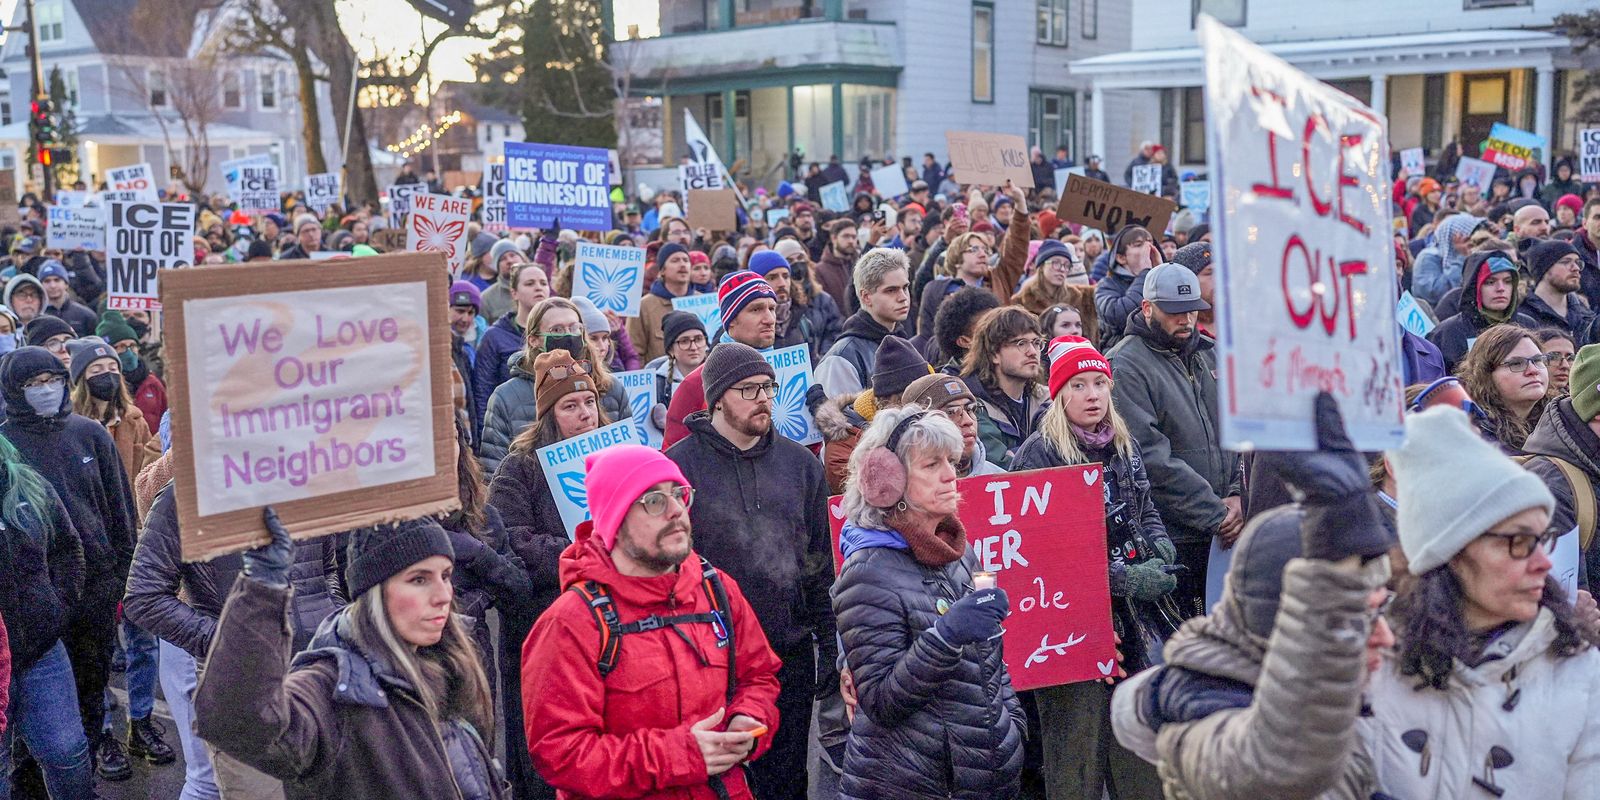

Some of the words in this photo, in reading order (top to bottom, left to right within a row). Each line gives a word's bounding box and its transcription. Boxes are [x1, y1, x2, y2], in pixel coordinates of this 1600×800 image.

[1584, 132, 1600, 143] IC
[1586, 144, 1600, 155] OU
[506, 147, 529, 156] Leave
[545, 151, 585, 160] neighbors
[1000, 147, 1025, 167] KILLS
[1250, 85, 1371, 239] ICE
[1511, 144, 1532, 157] OU
[508, 157, 538, 181] ICE
[542, 159, 579, 183] OUT
[583, 162, 606, 185] OF
[683, 175, 720, 190] ICE
[685, 163, 716, 178] KILLER
[115, 178, 148, 190] NO
[241, 180, 277, 191] ICE
[308, 185, 335, 198] ICE
[507, 180, 609, 208] MINNESOTA
[1069, 178, 1120, 204] DEPORT
[50, 207, 71, 221] ICE
[111, 202, 191, 230] ICE
[415, 195, 436, 211] WE
[441, 199, 468, 216] ARE
[1083, 200, 1153, 229] NOW
[116, 228, 154, 255] OUT
[160, 230, 185, 257] OF
[581, 245, 642, 262] REMEMBER
[111, 257, 190, 294] MP
[1281, 234, 1369, 342] OUT
[677, 294, 718, 309] REMEMBE
[219, 317, 284, 357] We
[316, 314, 399, 349] Love
[766, 349, 806, 371] EMBER
[274, 356, 345, 390] Our
[220, 385, 406, 438] Immigrant
[545, 424, 632, 467] REMEMBER
[222, 437, 407, 489] Neighbors
[984, 480, 1053, 526] IN
